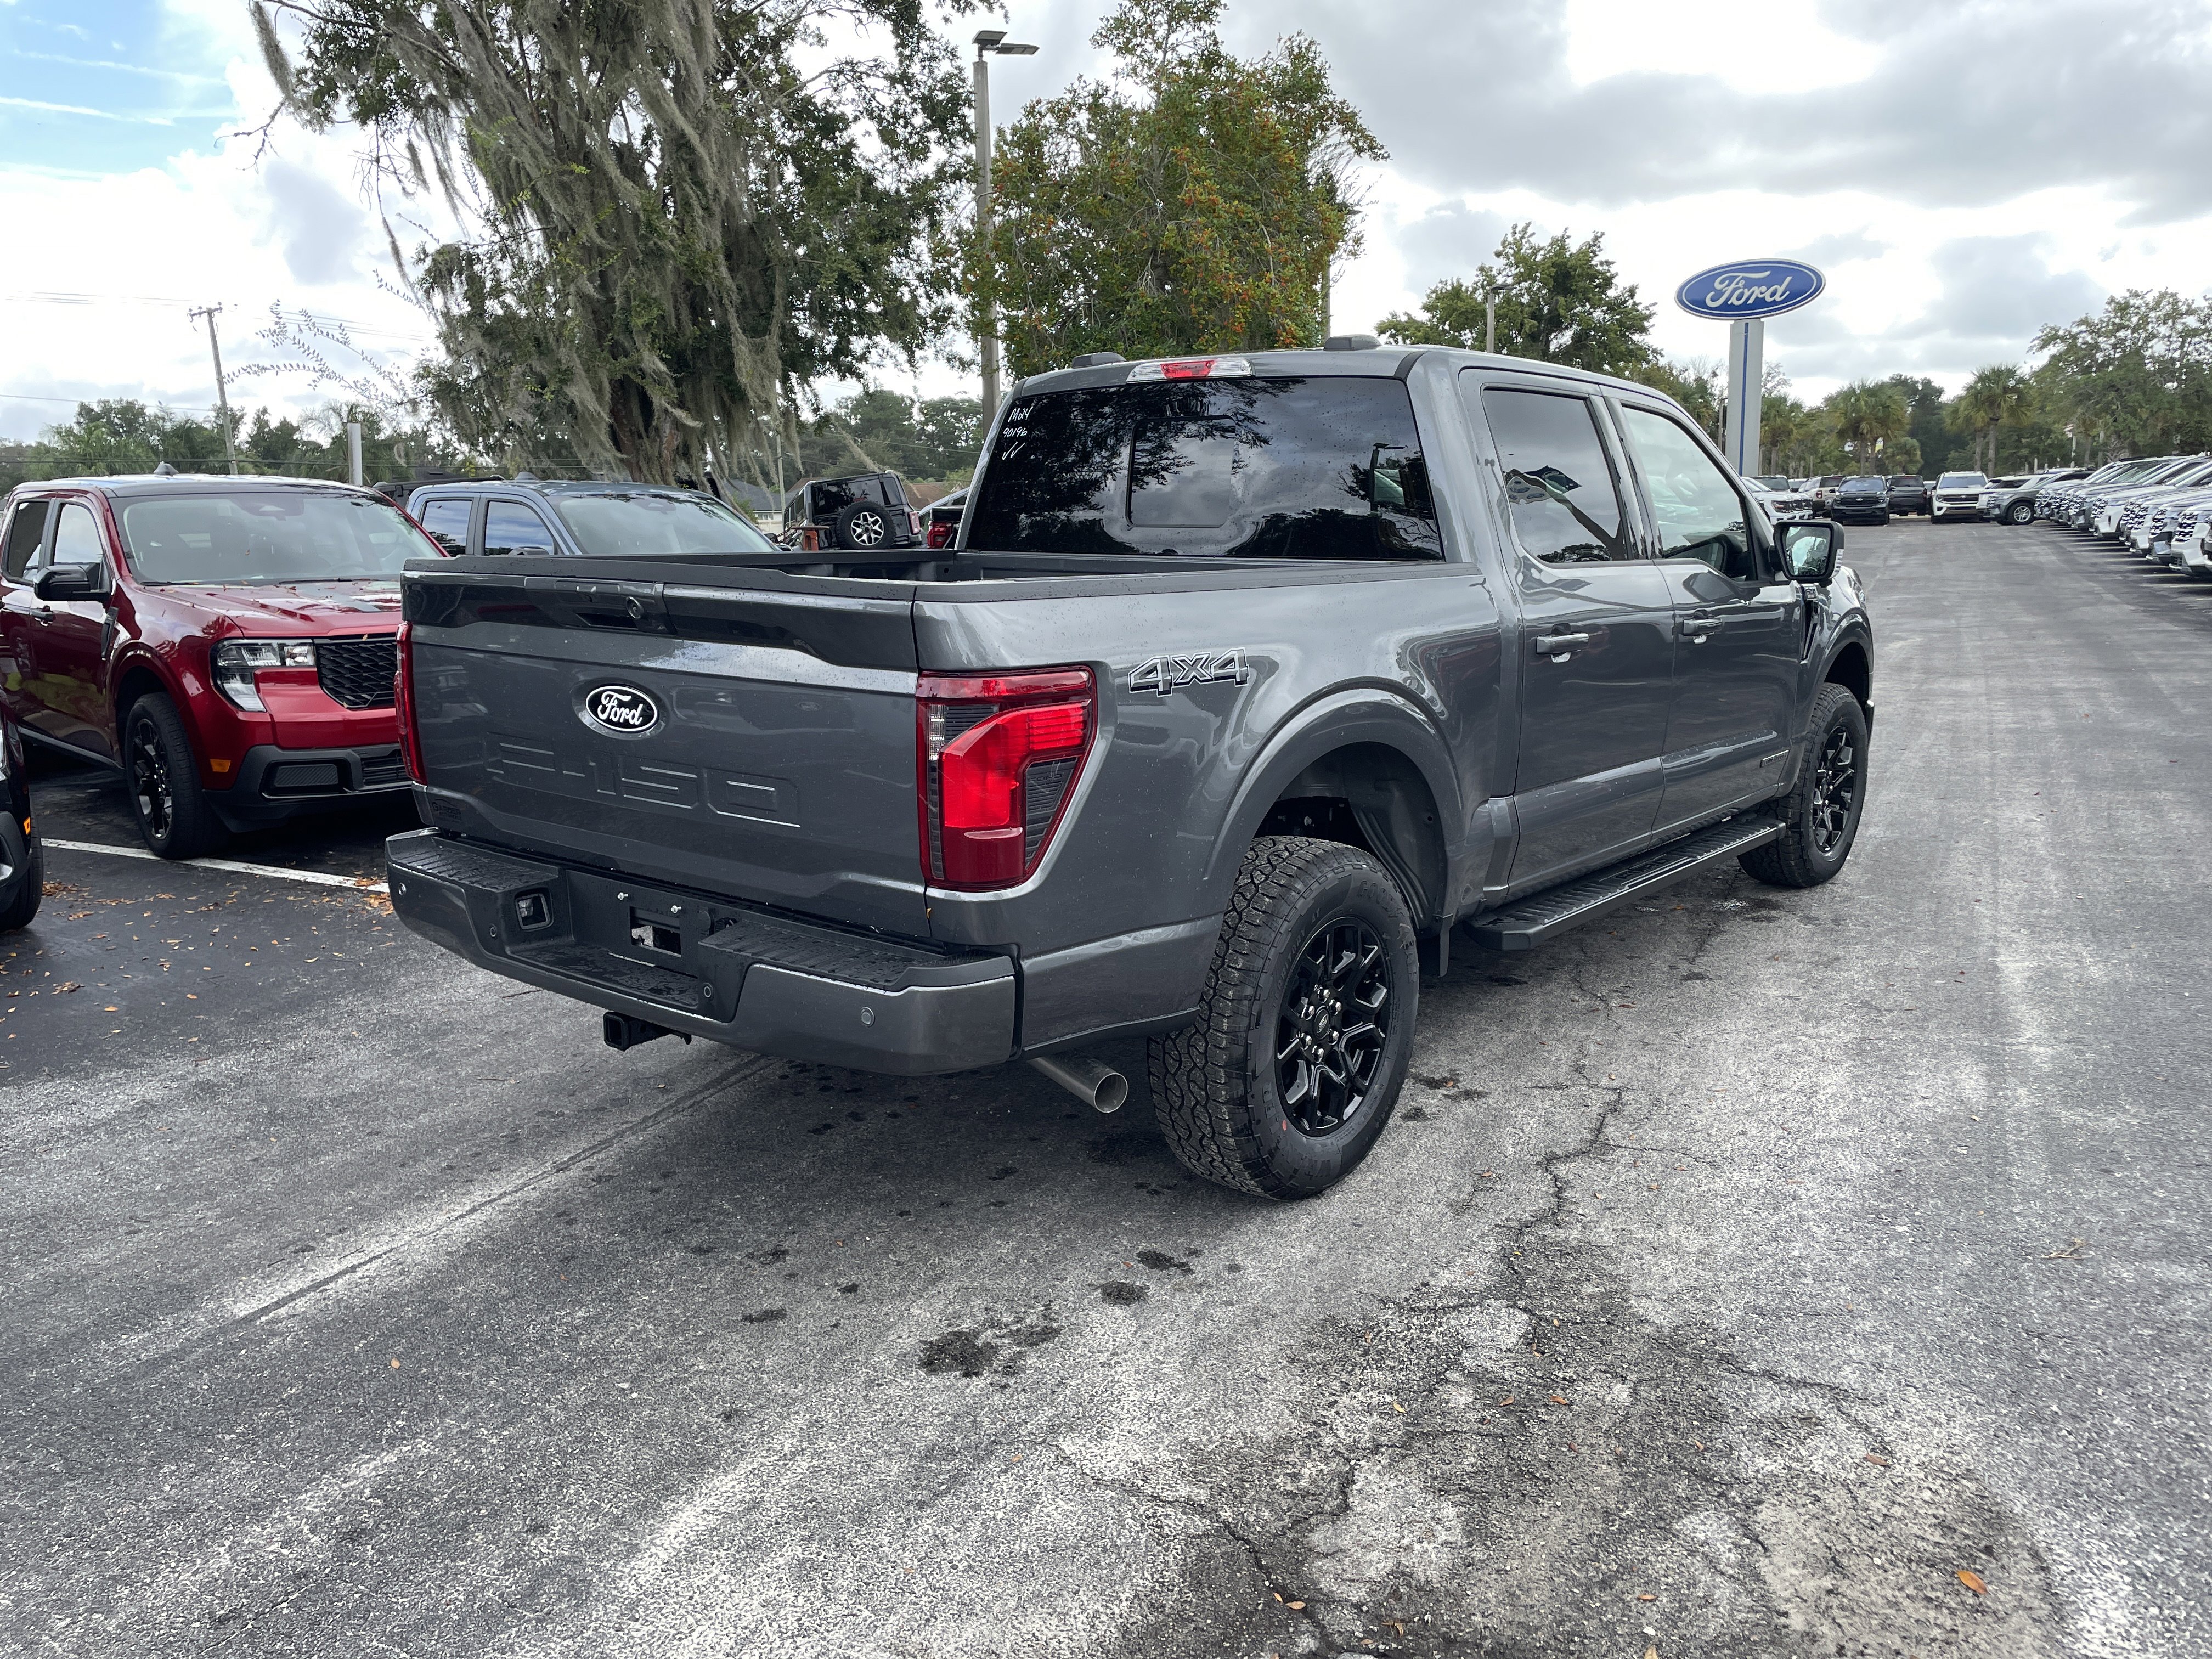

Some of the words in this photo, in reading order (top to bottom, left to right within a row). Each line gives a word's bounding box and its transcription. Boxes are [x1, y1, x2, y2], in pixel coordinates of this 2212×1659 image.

[1705, 270, 1793, 308] Ford
[1003, 426, 1028, 438] 90196
[597, 691, 644, 725] Ford
